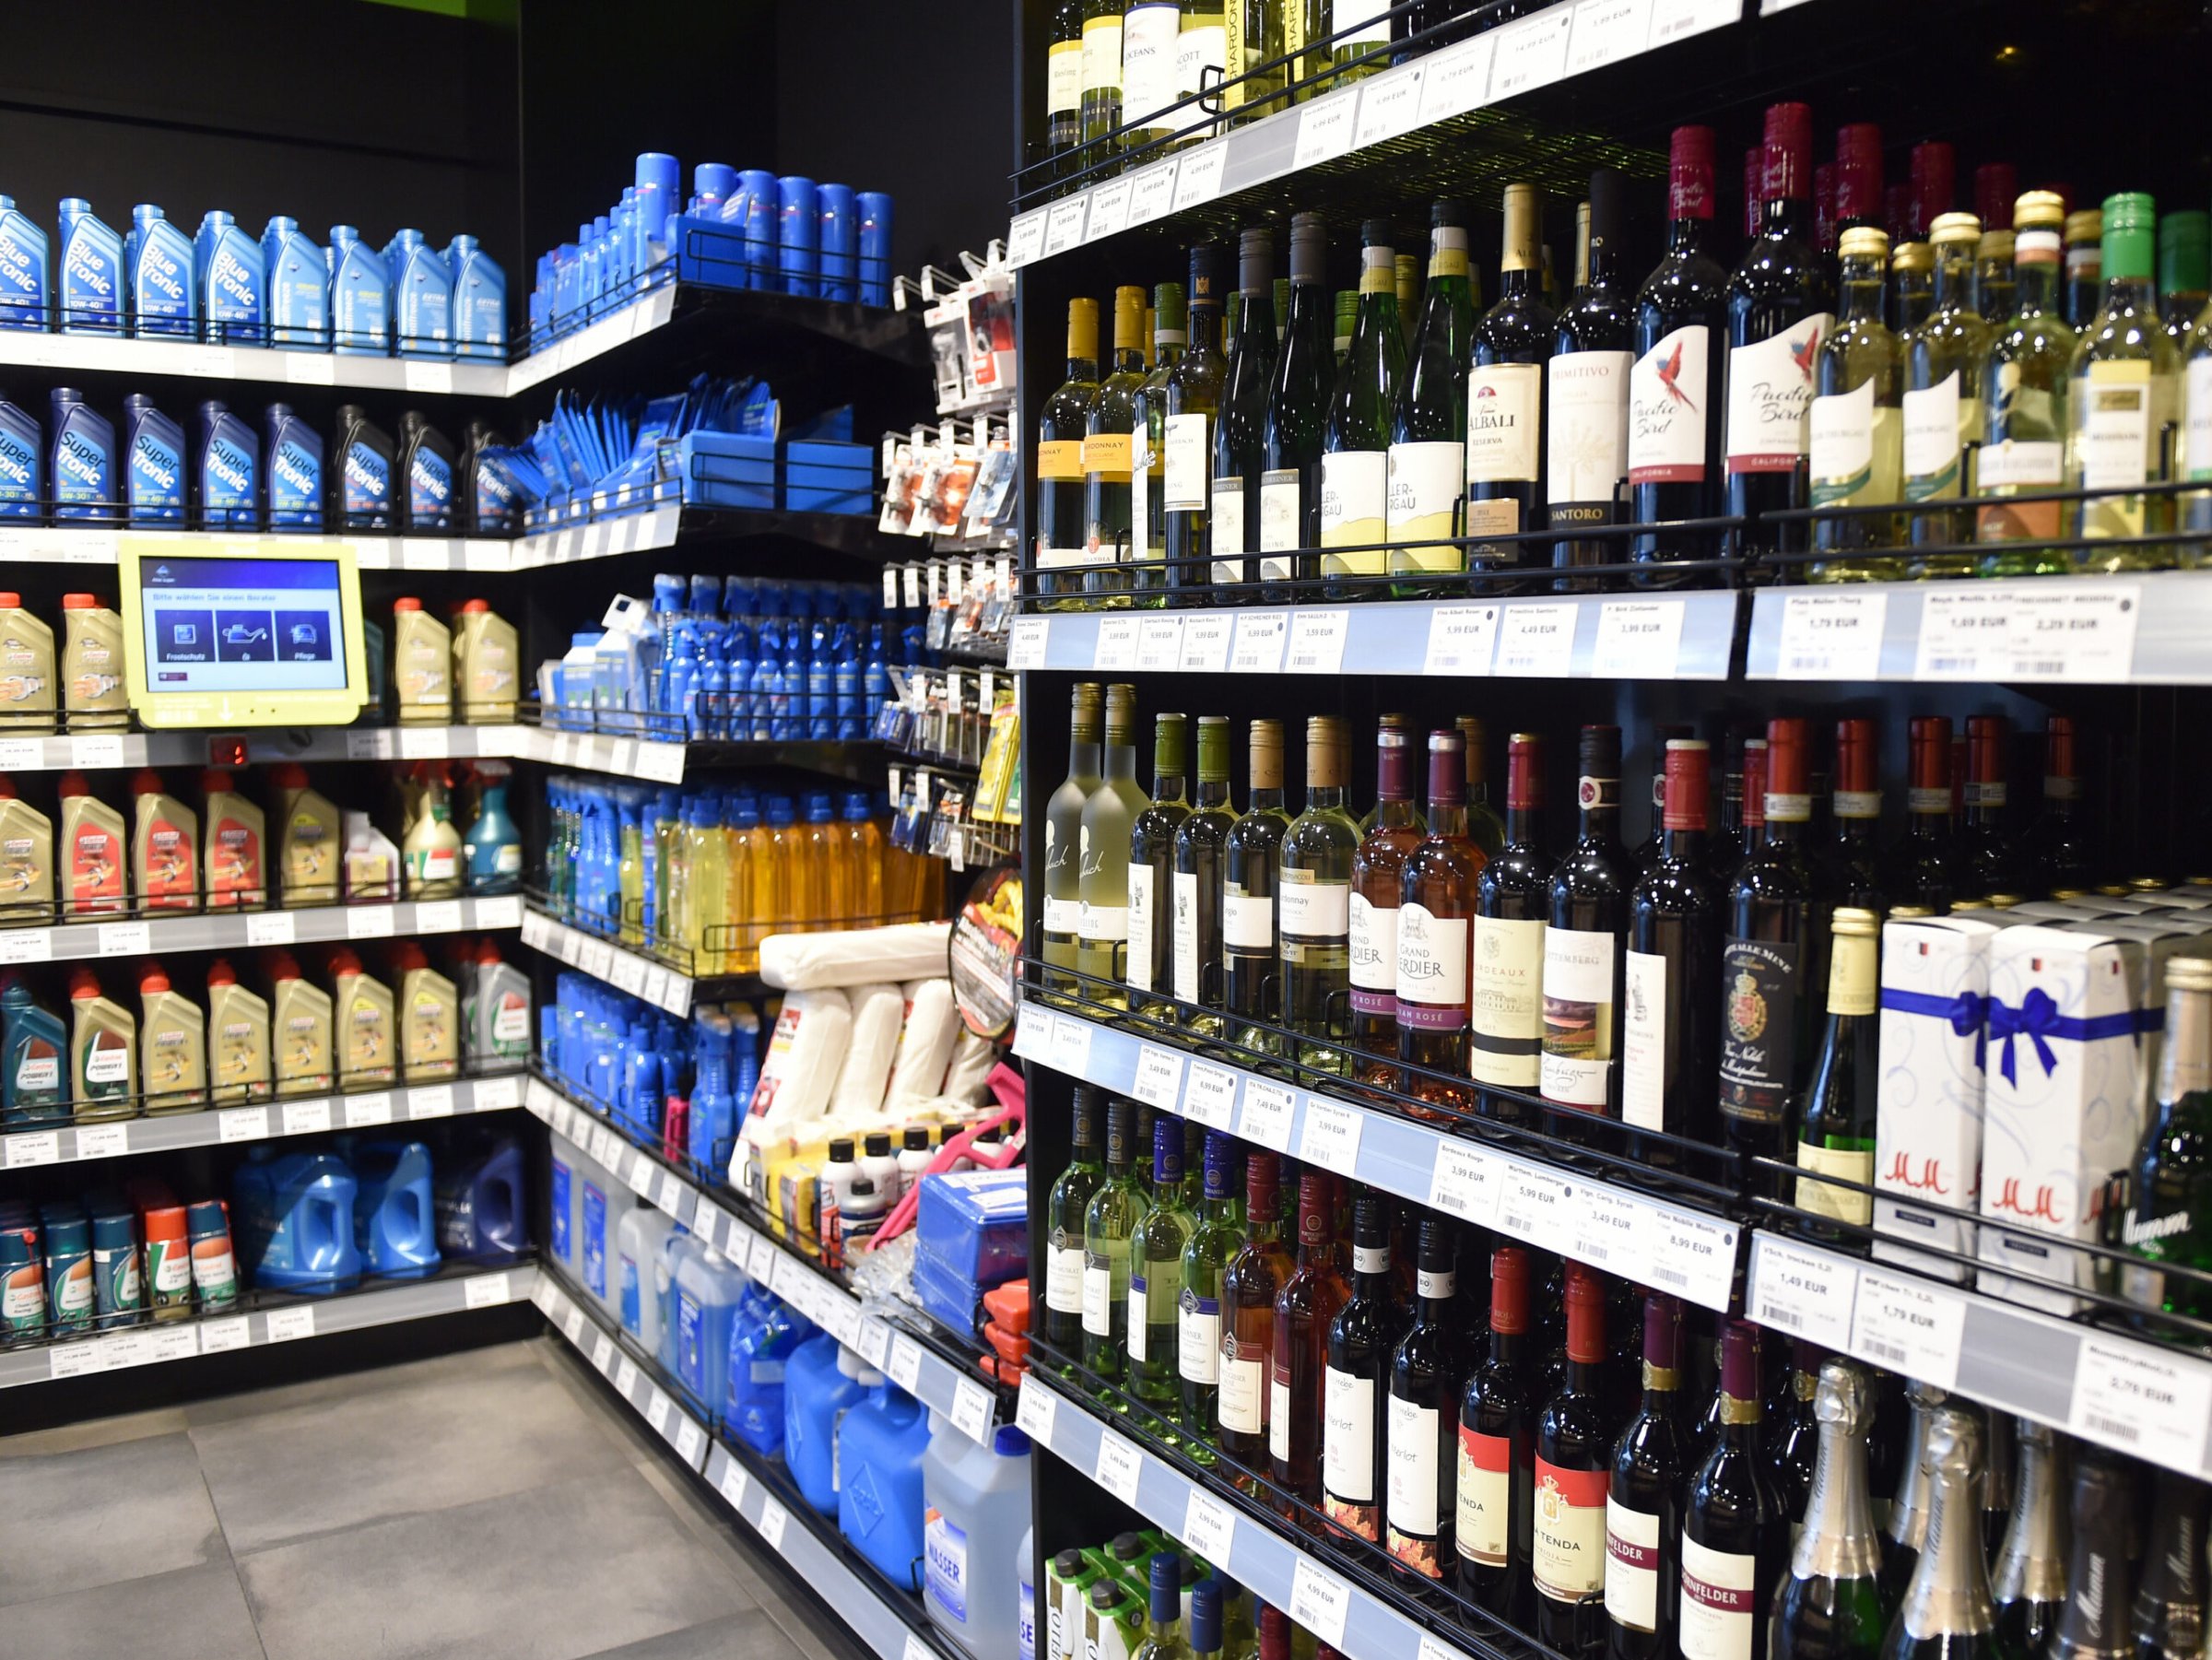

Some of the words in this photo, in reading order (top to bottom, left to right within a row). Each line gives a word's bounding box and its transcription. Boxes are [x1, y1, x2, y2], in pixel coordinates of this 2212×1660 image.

[1327, 113, 1341, 125] EUR
[71, 240, 105, 271] Blue
[144, 245, 178, 277] Blue
[68, 256, 112, 295] Tronic
[218, 252, 251, 283] Blue
[141, 262, 184, 300] Tronic
[215, 267, 255, 307] Tronic
[1553, 366, 1609, 380] PRIMITIVO
[1751, 381, 1813, 405] Pacific
[1633, 397, 1680, 420] Pacific
[1760, 403, 1811, 424] Bird
[1468, 414, 1515, 431] ALBALI
[1637, 418, 1673, 440] Bird
[61, 431, 107, 468] Super
[135, 435, 180, 472] Super
[210, 439, 253, 475] Super
[278, 442, 320, 477] Super
[58, 446, 101, 487] Tronic
[133, 450, 175, 489] Tronic
[349, 445, 385, 479] Super
[414, 449, 451, 482] Super
[207, 453, 248, 492] Tronic
[275, 455, 315, 495] Tronic
[346, 457, 385, 496] Tronic
[410, 462, 449, 500] Tronic
[1551, 508, 1604, 522] SANTORO
[152, 593, 173, 602] Bitte
[175, 593, 205, 602] wählen
[206, 594, 220, 602] Sie
[1320, 628, 1334, 636] EUR
[1464, 624, 1480, 633] EUR
[1521, 625, 1538, 634] 4,49
[1540, 624, 1558, 633] EUR
[1641, 623, 1662, 633] EUR
[1836, 618, 1859, 628] EUR
[1981, 617, 2007, 628] EUR
[2069, 618, 2099, 630] EUR
[1207, 630, 1219, 639] EUR
[1261, 629, 1274, 638] EUR
[166, 653, 206, 662] Frostschutz
[294, 652, 316, 662] Pflege
[1401, 944, 1430, 959] GRAND
[1359, 996, 1382, 1007] ROSÉ
[1416, 1011, 1443, 1022] ROSÉ
[1148, 1064, 1159, 1074] 3,49
[1160, 1066, 1171, 1077] EUR
[1211, 1083, 1224, 1094] EUR
[1256, 1099, 1269, 1109] 7,49
[1269, 1102, 1282, 1113] EUR
[1318, 1121, 1332, 1132] 3,99
[1333, 1124, 1347, 1136] EUR
[1441, 1145, 1465, 1158] Bordeaux
[1467, 1152, 1484, 1163] Rouge
[1452, 1165, 1467, 1177] 3,99
[1468, 1171, 1485, 1183] EUR
[1520, 1186, 1536, 1198] 5,99
[1538, 1192, 1556, 1205] EUR
[1592, 1210, 1610, 1224] 3,49
[1612, 1217, 1631, 1230] EUR
[1670, 1235, 1690, 1249] 8,99
[1692, 1242, 1712, 1255] EUR
[1781, 1273, 1802, 1288] 1,49
[1805, 1277, 1828, 1295] EUR
[1883, 1304, 1906, 1320] 1,79
[1910, 1312, 1936, 1328] EUR
[2145, 1387, 2176, 1405] EUR
[1327, 1412, 1354, 1431] Merlot
[1391, 1442, 1418, 1463] Merlot
[1198, 1512, 1210, 1525] 2,99
[1210, 1519, 1222, 1531] EUR
[1540, 1532, 1581, 1552] TENDA
[929, 1541, 960, 1583] WASSER
[1307, 1583, 1321, 1596] 4,99
[1321, 1592, 1335, 1606] EUR
